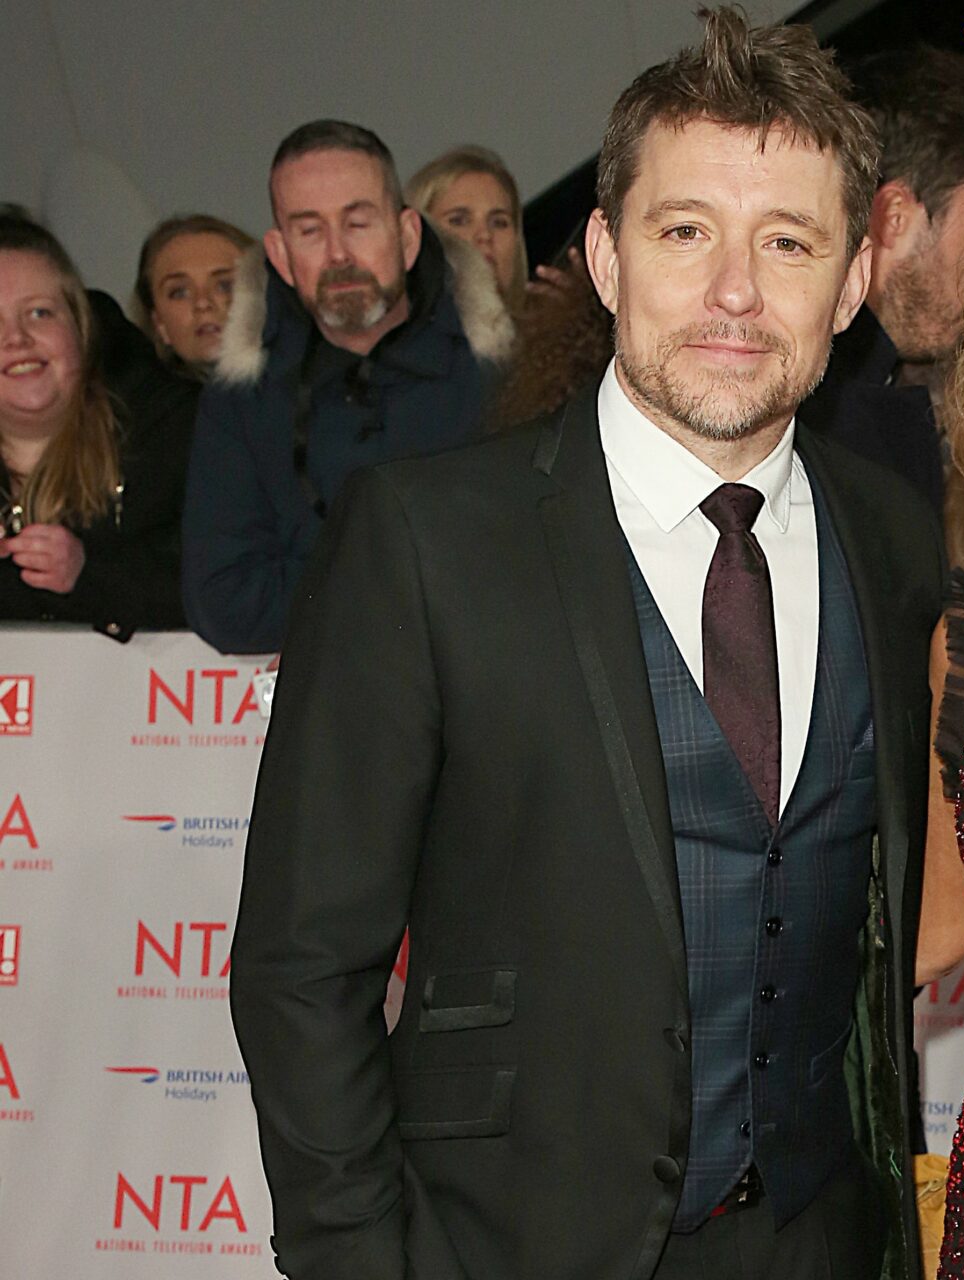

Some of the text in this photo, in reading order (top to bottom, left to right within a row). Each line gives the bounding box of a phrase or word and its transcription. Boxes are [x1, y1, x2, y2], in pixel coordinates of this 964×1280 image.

[130, 735, 181, 747] NATIONAL
[189, 735, 247, 747] TELEVISION
[183, 817, 239, 830] BRITISH
[182, 835, 233, 848] Holidays
[135, 919, 231, 978] NT
[117, 986, 229, 1000] NATIONAL TELEVISIO
[166, 1070, 222, 1083] BRITISH
[165, 1087, 217, 1102] Holidays
[113, 1171, 247, 1233] NTA
[96, 1239, 262, 1256] NATIONAL TELEVISION AWARDS
